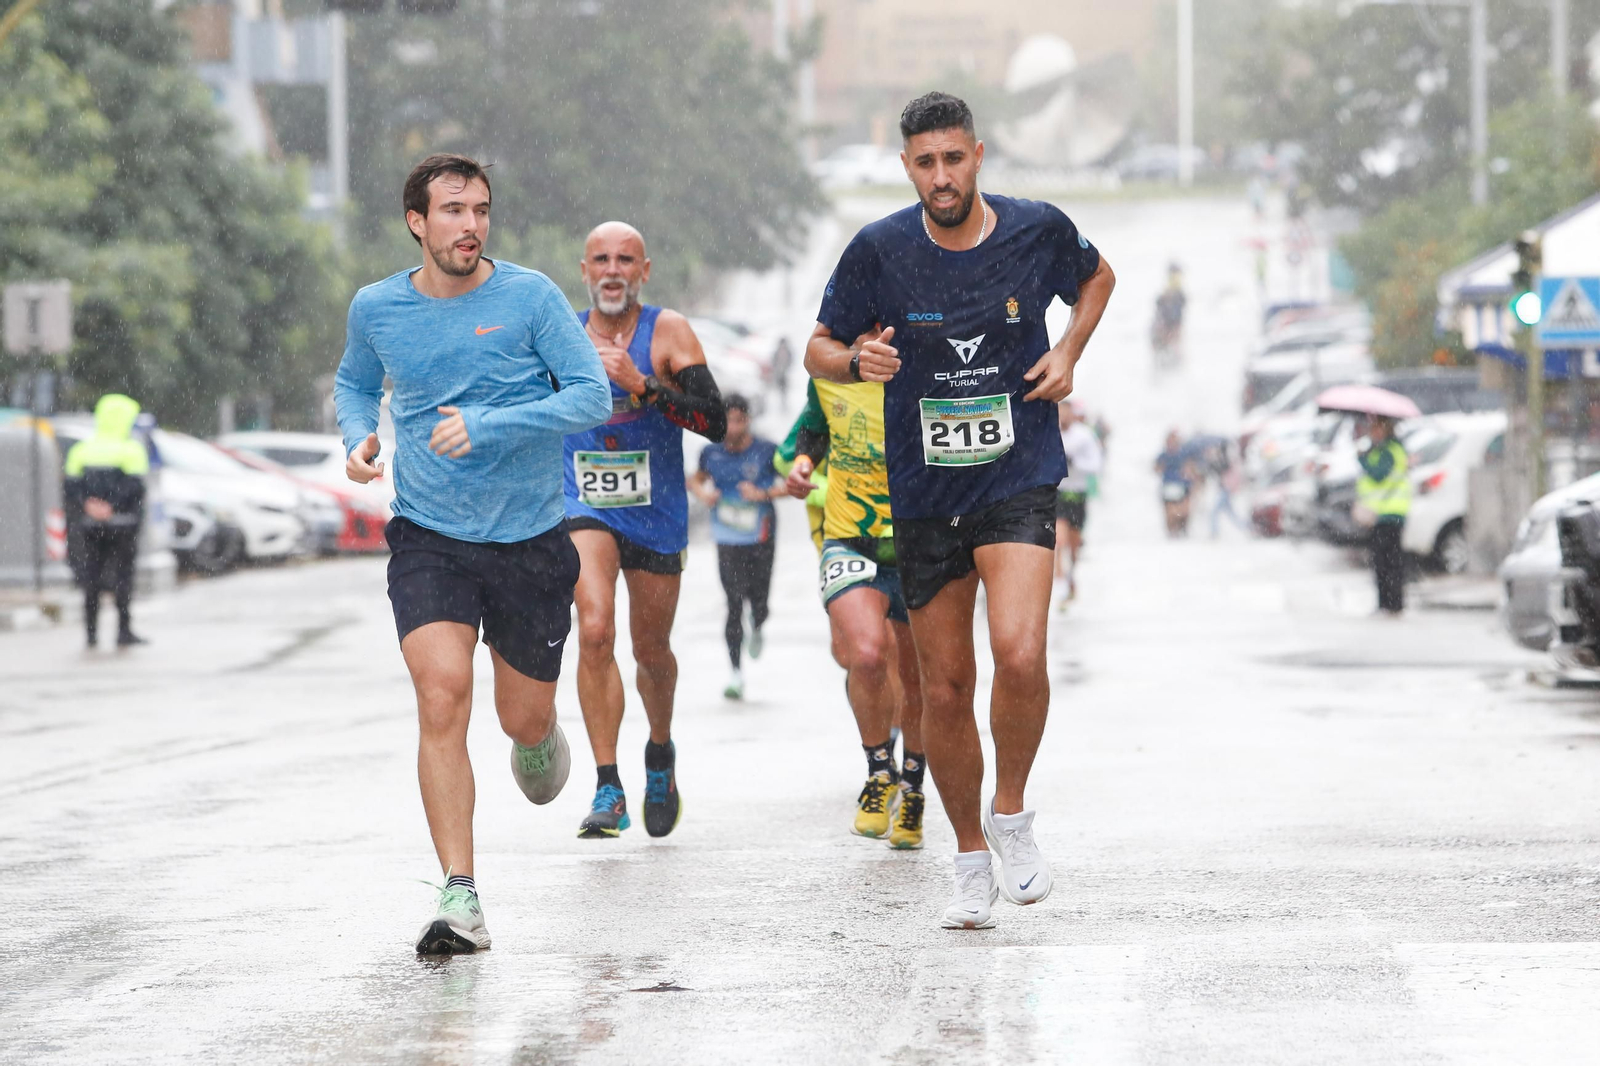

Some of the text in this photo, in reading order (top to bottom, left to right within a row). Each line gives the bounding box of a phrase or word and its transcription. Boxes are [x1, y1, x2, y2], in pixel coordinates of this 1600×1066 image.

[934, 366, 999, 380] CUPRA
[949, 378, 979, 387] TURIAL
[930, 420, 1001, 447] 218
[583, 471, 637, 492] 291
